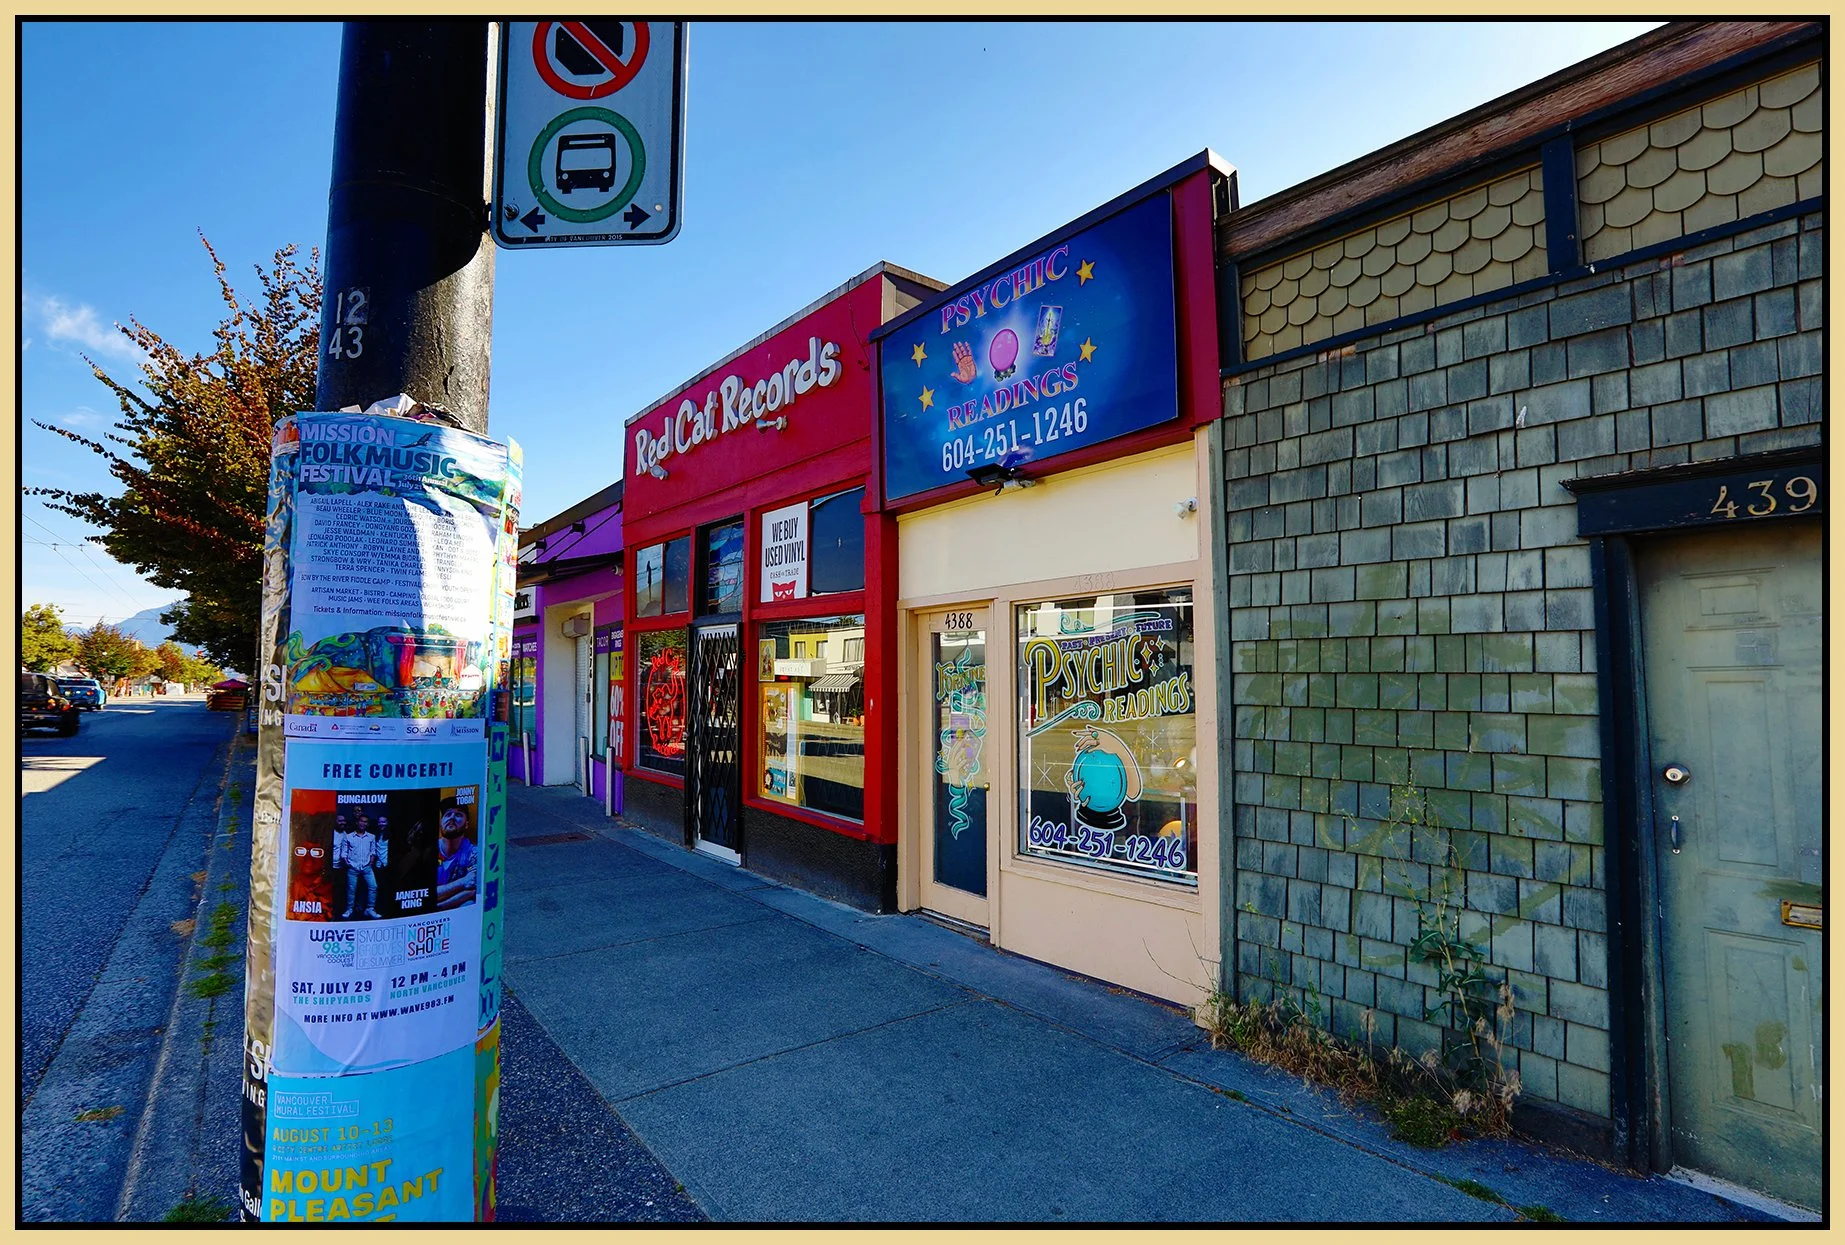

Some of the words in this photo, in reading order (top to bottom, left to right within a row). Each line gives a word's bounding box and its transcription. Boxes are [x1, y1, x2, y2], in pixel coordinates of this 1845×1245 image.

[940, 245, 1069, 335] PSYCHIC
[336, 290, 368, 325] 12
[328, 326, 363, 359] 43
[946, 361, 1079, 432] READINGS
[635, 417, 674, 477] Red
[674, 391, 718, 454] Cat
[719, 336, 842, 434] Records
[300, 423, 395, 447] MISSION
[941, 397, 1088, 472] 604-251-1246
[300, 442, 364, 467] FOLK
[363, 446, 456, 479] MUSIC
[300, 464, 396, 488] FESTIVAL
[1711, 476, 1818, 518] 439
[330, 499, 353, 507] LAPELL
[391, 502, 405, 510] AND
[332, 505, 362, 514] WHEELER
[366, 508, 382, 516] BLUE
[384, 509, 402, 517] MOON
[335, 513, 359, 521] CEDRIC
[359, 515, 386, 523] WATSON
[332, 520, 361, 528] FRANCEY
[365, 523, 400, 531] DONGYANG
[771, 521, 783, 543] WE
[784, 517, 799, 541] BUY
[307, 533, 334, 541] LEONARD
[334, 534, 364, 543] PODOLAK
[368, 537, 398, 546] LEONARD
[342, 528, 375, 537] WALDMAN
[380, 531, 413, 540] KENTUCKY
[329, 541, 359, 550] ANTHONY
[363, 544, 385, 552] ROBYN
[386, 546, 409, 554] LAYNE
[340, 550, 370, 559] CONSORT
[765, 544, 783, 568] USED
[784, 540, 806, 565] VINYL
[311, 555, 348, 564] STRONGBOW
[356, 557, 372, 565] WRY
[376, 559, 399, 568] TANIKA
[355, 565, 386, 573] SPENCER
[390, 567, 407, 575] TWIN
[332, 575, 350, 584] RIVER
[351, 577, 372, 585] FIDDLE
[372, 578, 391, 586] CAMP
[395, 580, 422, 589] FESTIVAL
[335, 588, 359, 596] MARKET
[389, 591, 417, 600] CAMPING
[381, 598, 400, 606] FOLKS
[313, 605, 335, 613] Tickets
[343, 607, 384, 616] Information:
[945, 612, 973, 630] 4388
[1061, 640, 1083, 650] PAST
[1089, 628, 1127, 647] PRESENT
[1135, 619, 1173, 633] FUTURE
[1103, 671, 1190, 723] READINGS
[289, 722, 318, 733] Canada
[406, 726, 437, 734] SOCAN
[323, 763, 362, 778] FREE
[369, 762, 453, 778] CONCERT!
[455, 786, 476, 797] JONNY
[337, 794, 387, 804] BUNGALOW
[456, 795, 475, 805] TOBIN
[1029, 815, 1187, 869] 604-251-1246
[395, 888, 429, 901] JANETTE
[293, 900, 323, 914] AHSIA
[401, 898, 423, 909] KING
[310, 929, 355, 942] WAVE
[360, 927, 404, 943] SMOOTH
[408, 922, 450, 944] NORTH
[322, 942, 355, 954] 98.3
[359, 941, 405, 956] GROOVES
[408, 938, 450, 957] SHORE
[368, 954, 404, 967] SUMMER
[391, 976, 406, 988] 12
[410, 971, 429, 986] PM
[441, 966, 448, 978] 4
[451, 961, 467, 976] PM
[319, 980, 350, 994] JULY
[354, 980, 373, 992] 29
[390, 986, 419, 1000] NORTH
[422, 974, 467, 995] VANCOUVER
[293, 996, 310, 1005] THE
[312, 994, 371, 1005] SHIPYARDS
[304, 1014, 328, 1023] MORE
[331, 1013, 353, 1023] INFO
[356, 1012, 369, 1022] AT
[370, 994, 455, 1021] WWW.WAVE983.FM
[276, 1095, 328, 1106] VANCOUVER
[276, 1106, 304, 1116] MURAL
[306, 1105, 355, 1116] FESTIVAL
[273, 1127, 330, 1143] AUGUST
[338, 1118, 394, 1141] 10-13
[332, 1142, 362, 1151] ARTIST
[270, 1158, 393, 1194] MOUNT
[270, 1167, 443, 1222] PLEASANT
